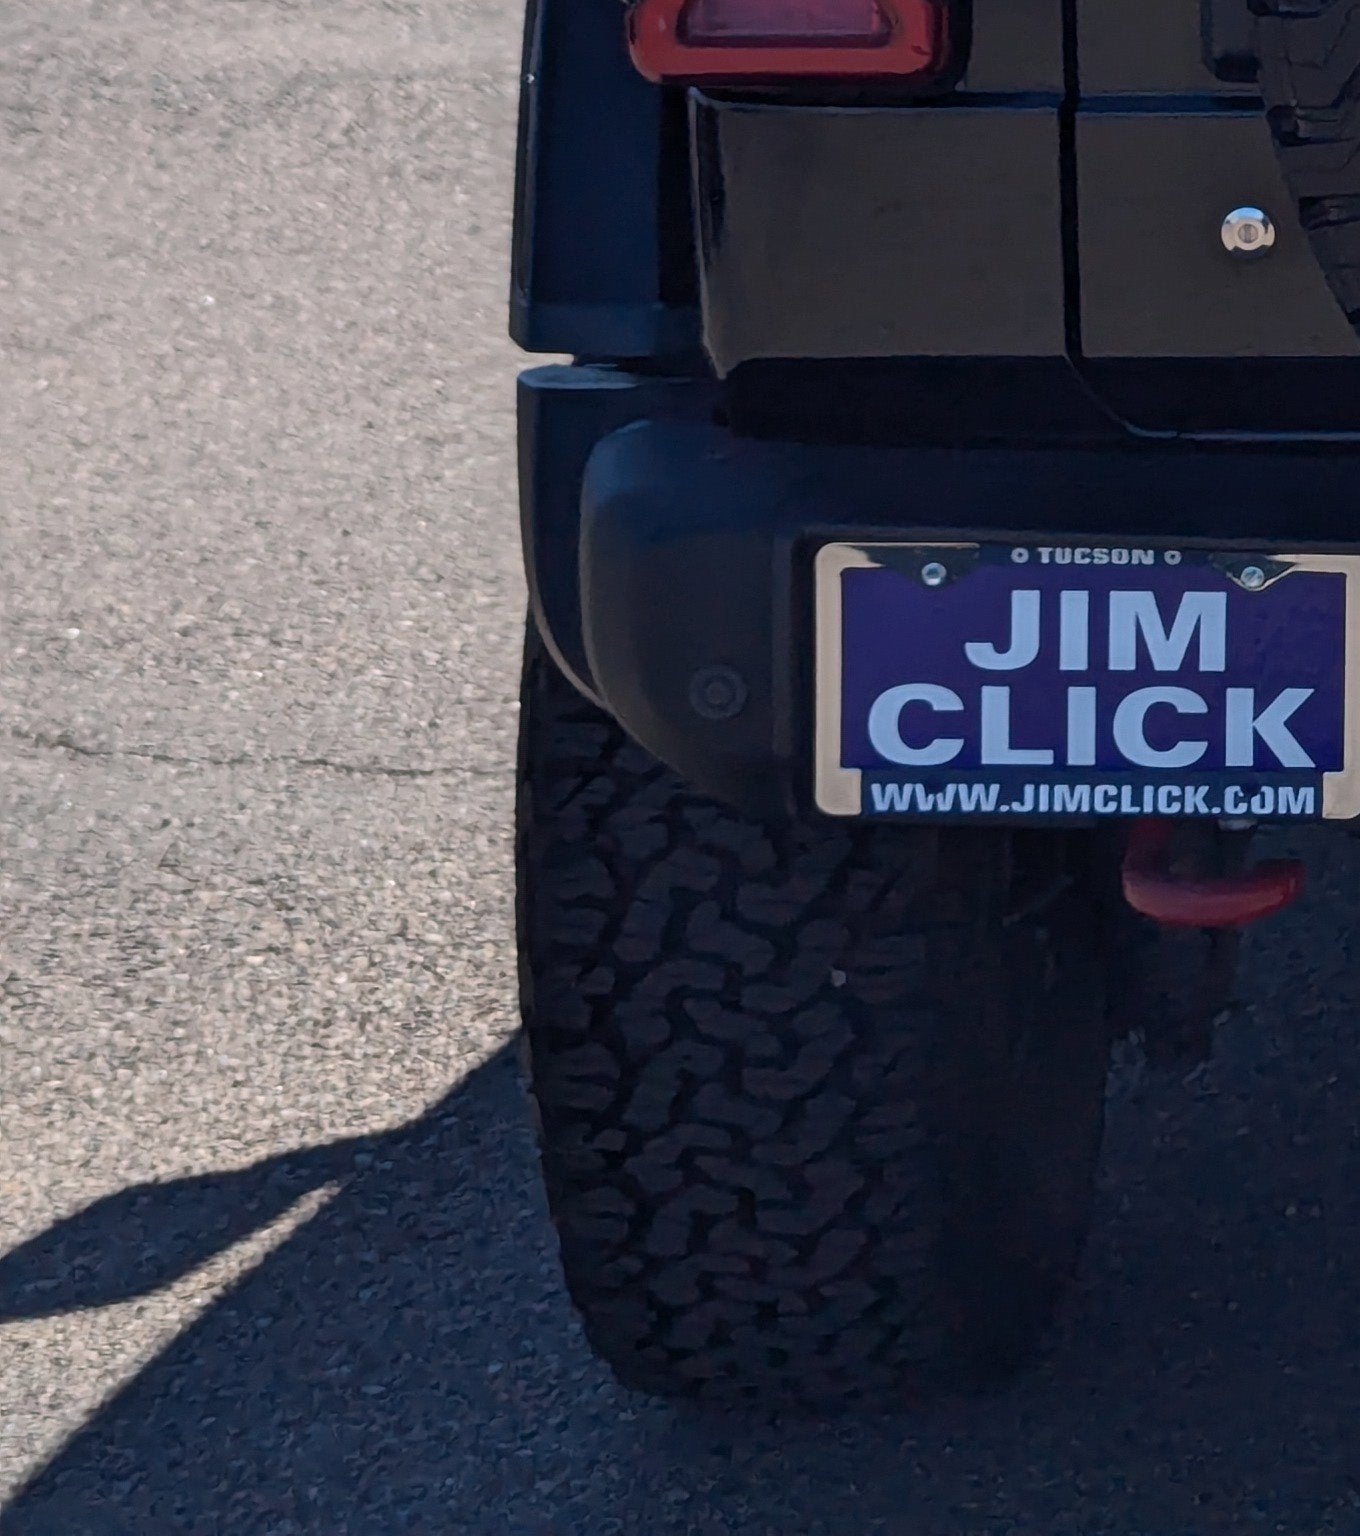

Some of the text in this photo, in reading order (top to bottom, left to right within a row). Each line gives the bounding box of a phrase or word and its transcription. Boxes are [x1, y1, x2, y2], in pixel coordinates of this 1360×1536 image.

[1037, 546, 1155, 566] TUCSON
[964, 589, 1227, 672] JIM
[867, 682, 1316, 768] CLICK
[871, 782, 1316, 816] WWW.JIMCLICK.COM
